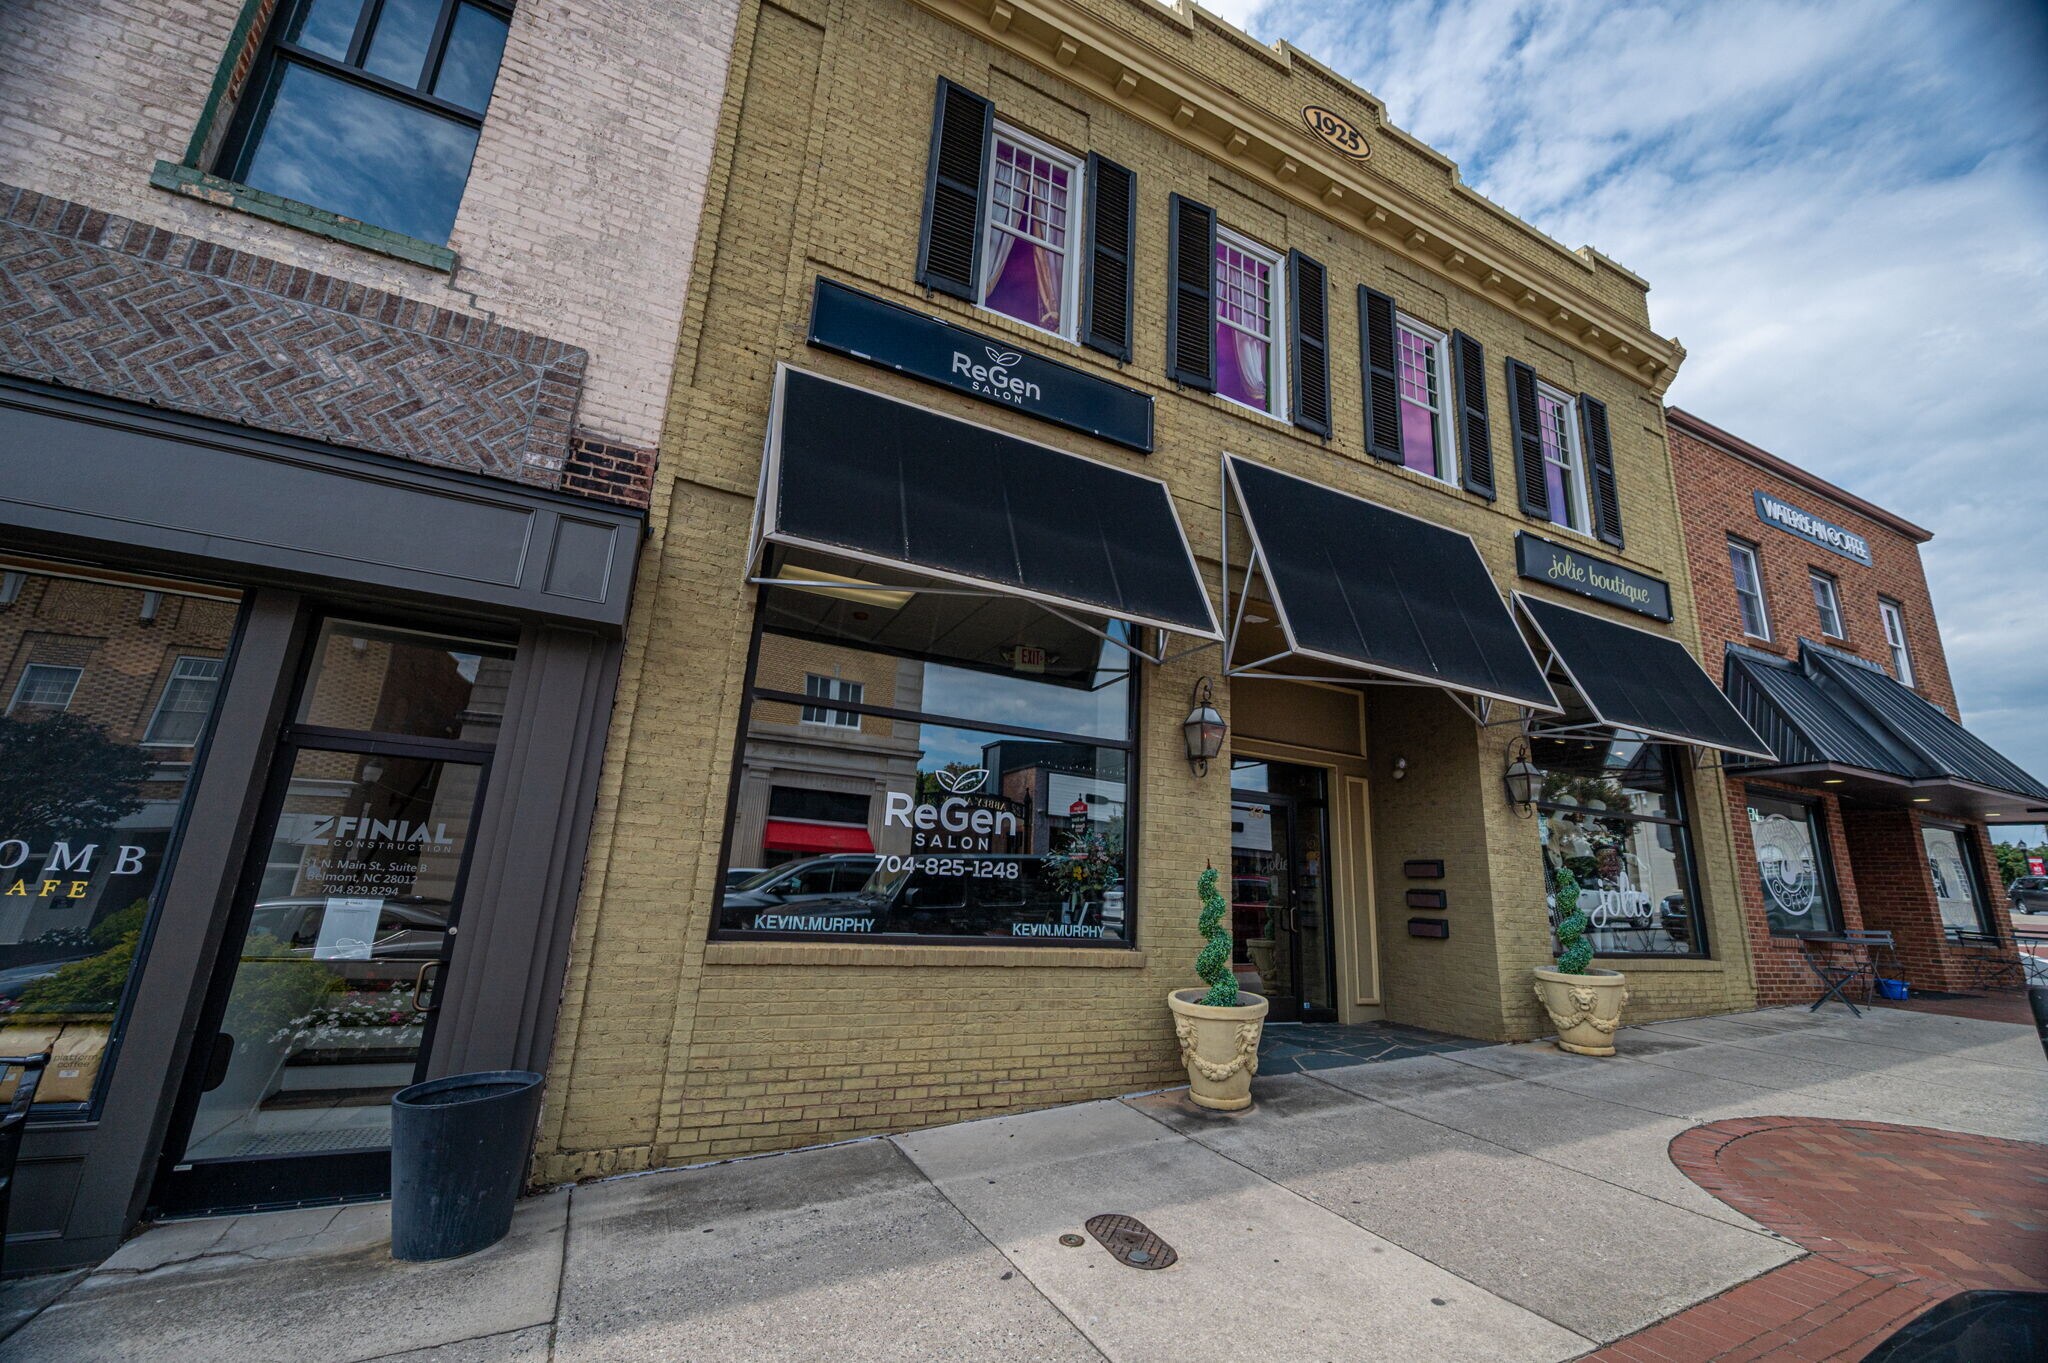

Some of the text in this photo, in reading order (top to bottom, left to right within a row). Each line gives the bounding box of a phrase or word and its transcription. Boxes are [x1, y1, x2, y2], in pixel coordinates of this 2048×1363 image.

[1314, 111, 1360, 151] 1925
[952, 351, 1040, 400] ReGen
[972, 381, 1022, 404] SALON
[1761, 497, 1869, 559] WATERBEAN COFFEE
[1548, 554, 1651, 606] jolie boutique
[1021, 647, 1041, 665] EXIT
[884, 791, 1017, 836] ReGen
[335, 815, 453, 844] FINIAL
[333, 839, 452, 853] CONSTRUCTION
[914, 832, 989, 851] SALON
[0, 839, 147, 875] OMB
[321, 859, 334, 869] N.
[337, 860, 366, 870] Main
[369, 861, 386, 873] St.,
[389, 862, 417, 873] Suite
[874, 855, 1019, 879] 704-825-1248
[4, 878, 89, 899] AFE
[307, 870, 418, 885] Belmont, NC 28012
[321, 884, 399, 896] 704.829.8294
[1591, 871, 1654, 928] jolie
[754, 914, 876, 933] KEVIN.MURPHY
[1012, 922, 1106, 938] KEVIN.MURPHY
